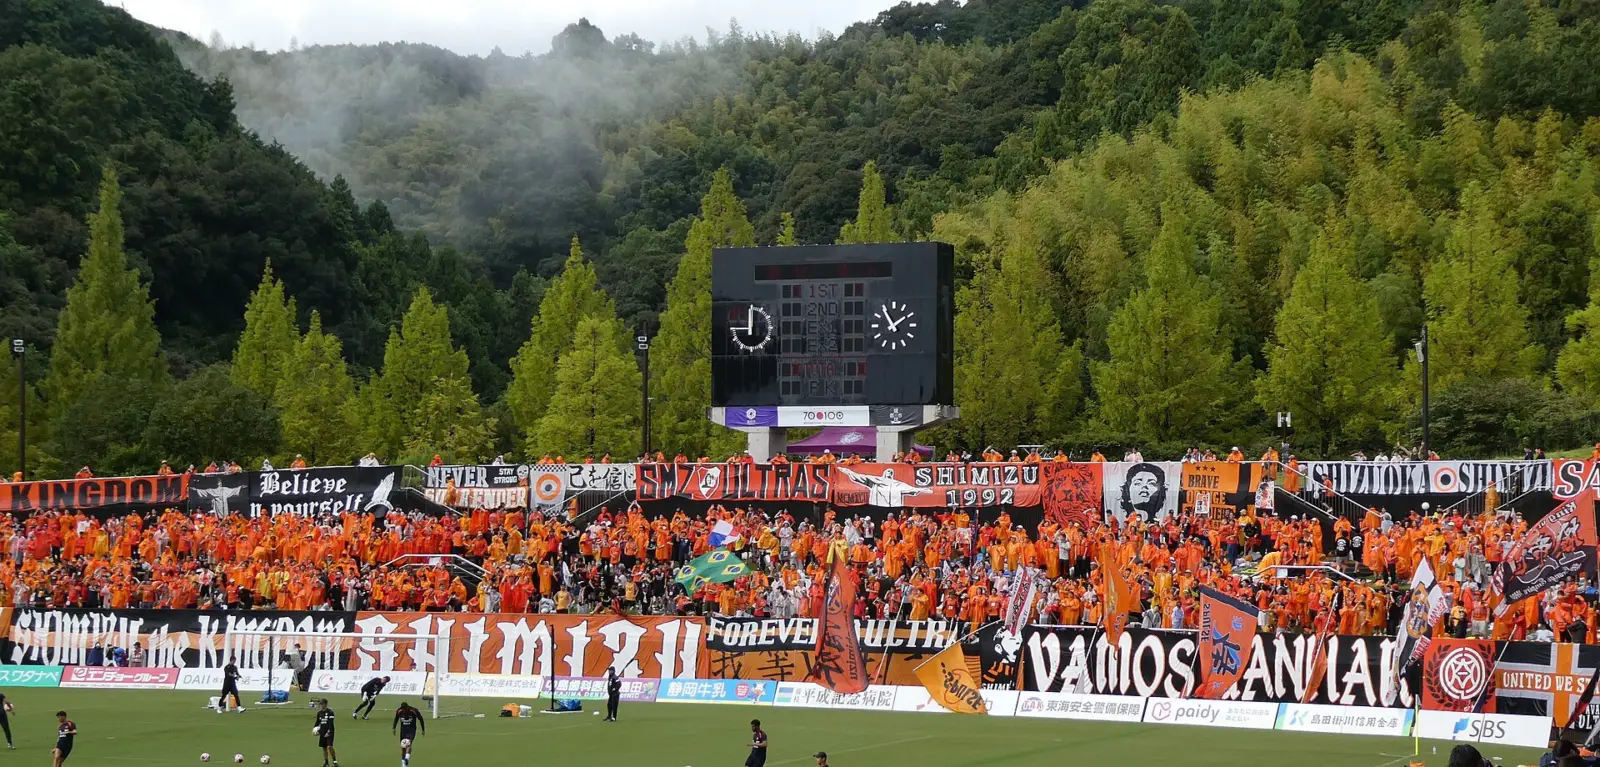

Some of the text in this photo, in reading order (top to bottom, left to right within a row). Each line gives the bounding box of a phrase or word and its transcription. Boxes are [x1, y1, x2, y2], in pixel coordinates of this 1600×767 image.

[809, 283, 838, 298] 1ST
[807, 302, 838, 316] 2ND
[427, 467, 489, 488] NEVER
[494, 476, 518, 485] STRONG
[499, 468, 514, 476] STAY
[915, 466, 1039, 486] SHIMIZU
[1188, 474, 1220, 489] BRAVE
[260, 472, 347, 497] Believe
[640, 465, 696, 499] SMZ
[723, 464, 829, 500] ULTRAS
[11, 476, 182, 510] KINGDOM
[947, 488, 1014, 506] 1992
[147, 623, 190, 668] the
[355, 613, 703, 680] SHIMIZU
[1028, 631, 1195, 698] VAMOS
[85, 669, 169, 683] エンチョーグループ
[1503, 672, 1552, 690] UNITED
[1556, 676, 1573, 692] WE
[667, 681, 727, 698] 静岡牛乳
[803, 688, 893, 707] 平成記念病院
[1046, 700, 1141, 716] 東海安全警備保障
[1175, 704, 1220, 723] paidy
[1311, 714, 1399, 729] 島田掛川信用金庫
[1469, 719, 1507, 739] SBS
